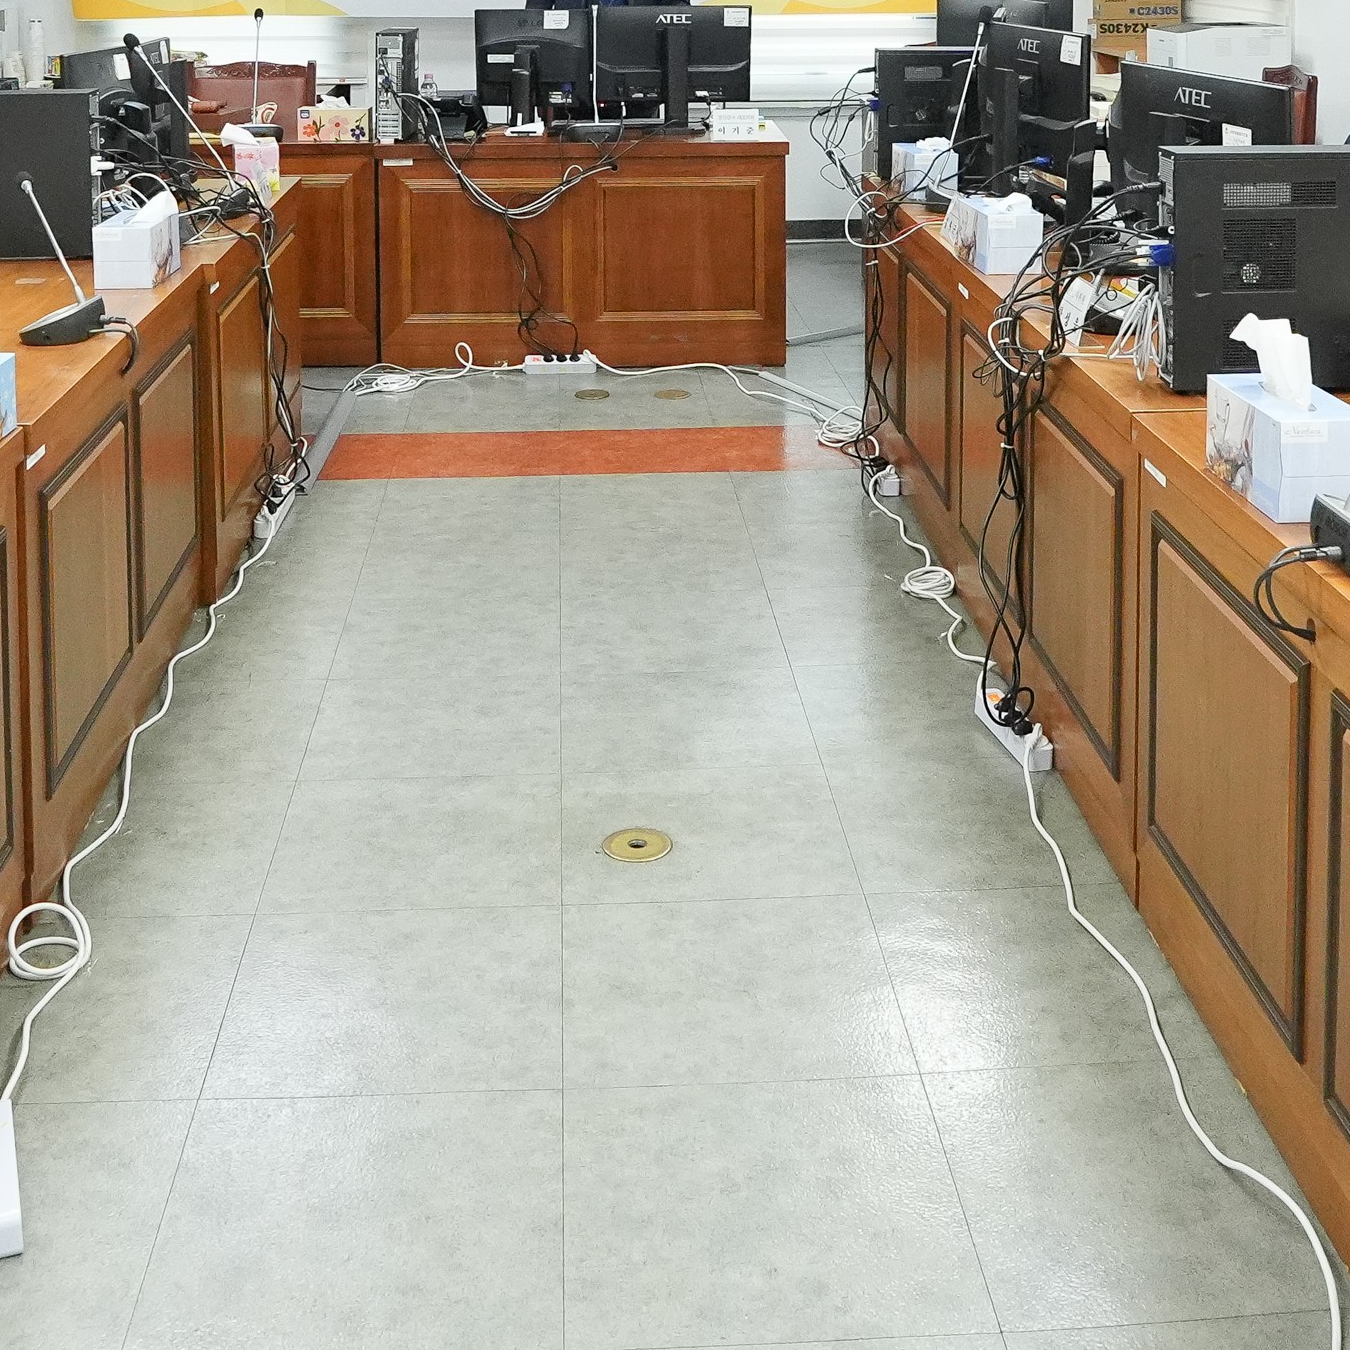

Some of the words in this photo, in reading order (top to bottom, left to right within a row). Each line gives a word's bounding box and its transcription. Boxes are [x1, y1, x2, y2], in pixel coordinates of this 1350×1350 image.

[1137, 6, 1179, 16] C2430S
[656, 14, 692, 24] ATEC
[1016, 38, 1041, 54] ATEC
[1173, 86, 1212, 109] ATEC
